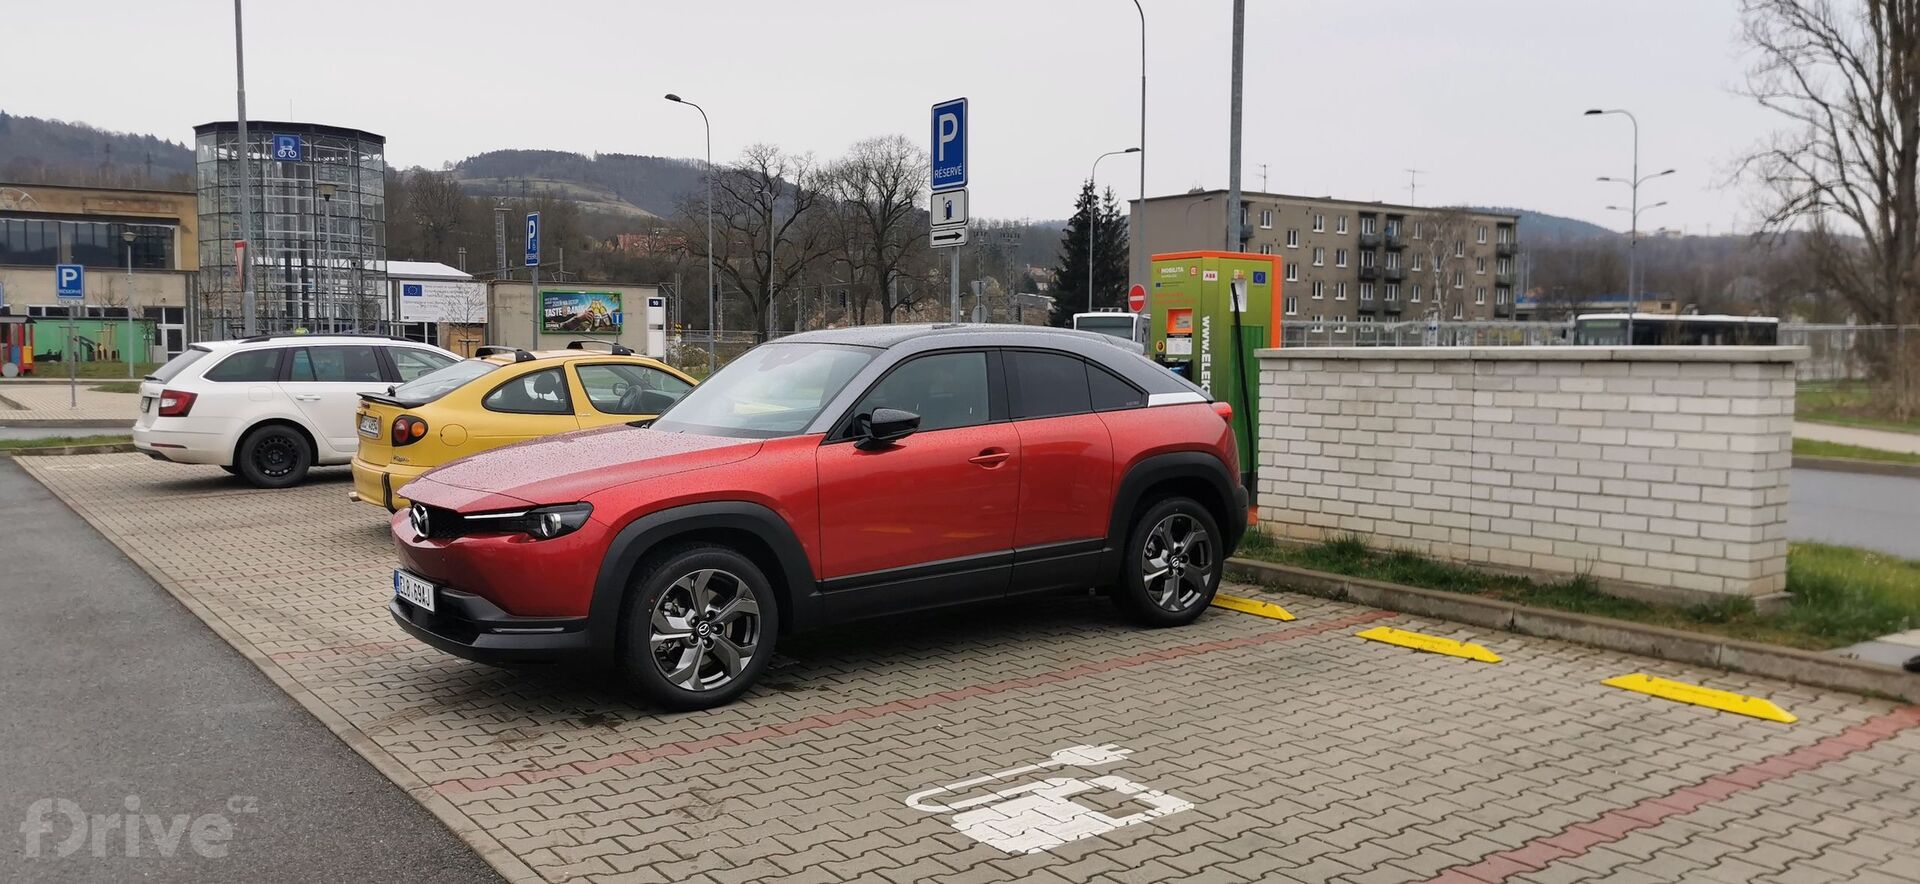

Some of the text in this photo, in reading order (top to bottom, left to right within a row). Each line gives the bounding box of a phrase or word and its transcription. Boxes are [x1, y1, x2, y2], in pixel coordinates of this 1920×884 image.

[939, 113, 958, 161] P
[935, 163, 962, 179] RÉSERVÉ
[528, 220, 535, 249] P
[62, 269, 78, 287] P
